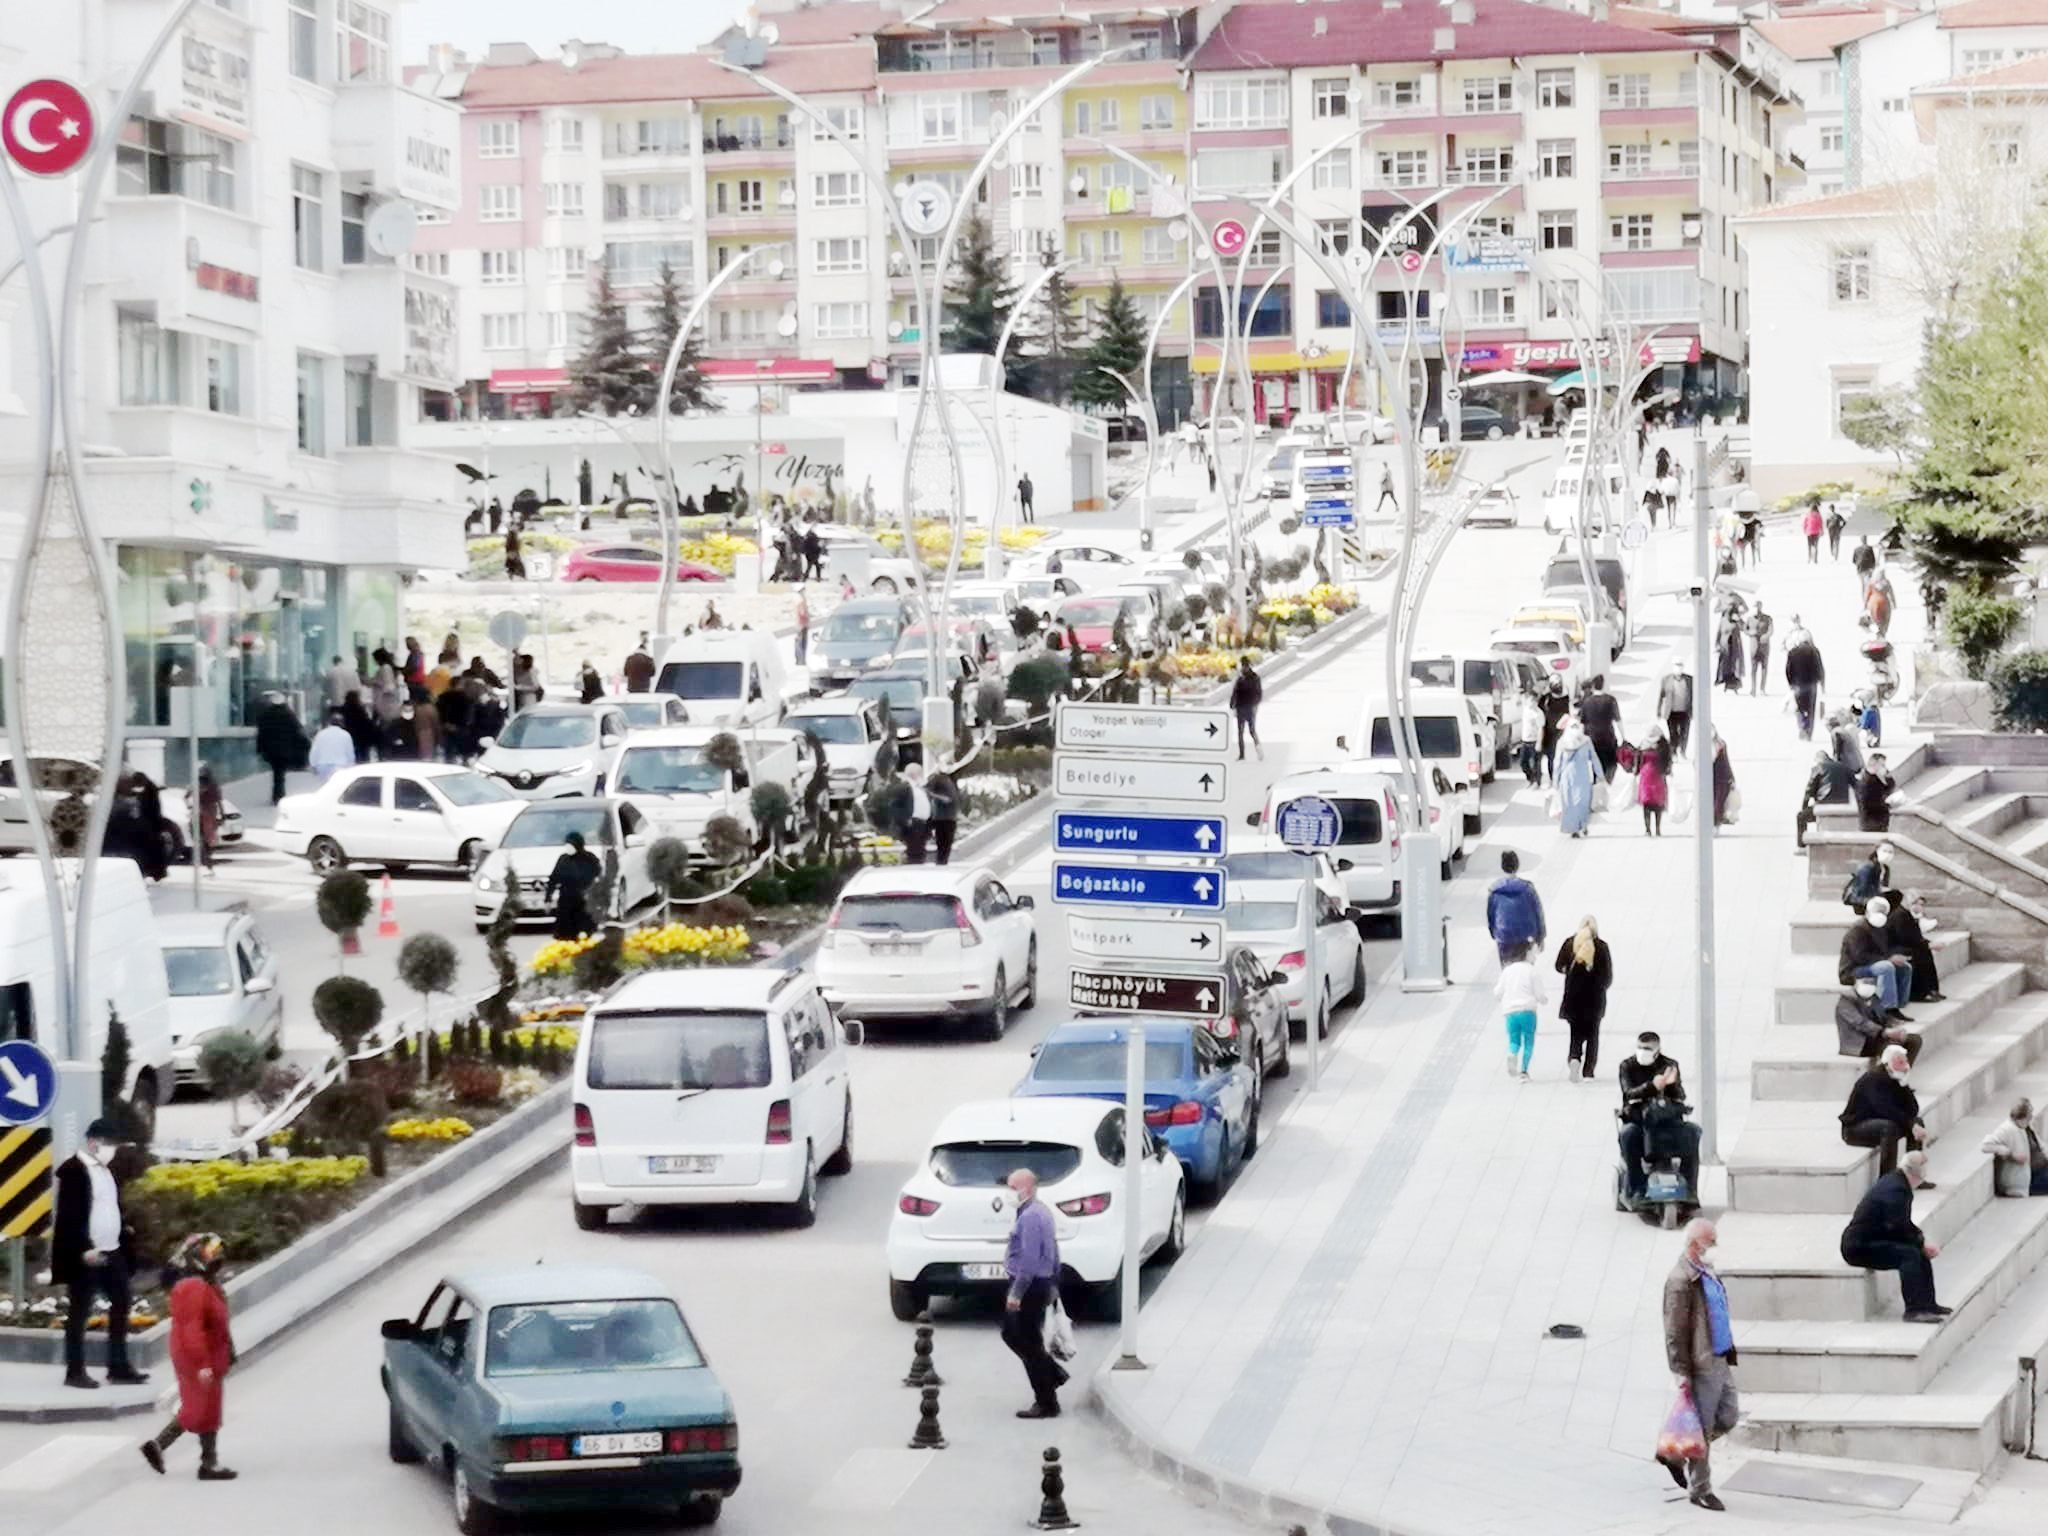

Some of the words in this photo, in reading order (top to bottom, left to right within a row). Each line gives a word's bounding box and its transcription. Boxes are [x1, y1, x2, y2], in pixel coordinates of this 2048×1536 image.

[407, 136, 450, 178] AVUKAT
[1092, 714, 1128, 727] Yozgat
[1066, 769, 1136, 787] Belediye
[1062, 823, 1138, 843] Sungurlu
[1061, 874, 1146, 894] Boğazkale
[1073, 972, 1166, 995] Alacahöyük
[1072, 987, 1139, 1009] Hattuşaş
[584, 1438, 601, 1451] 66
